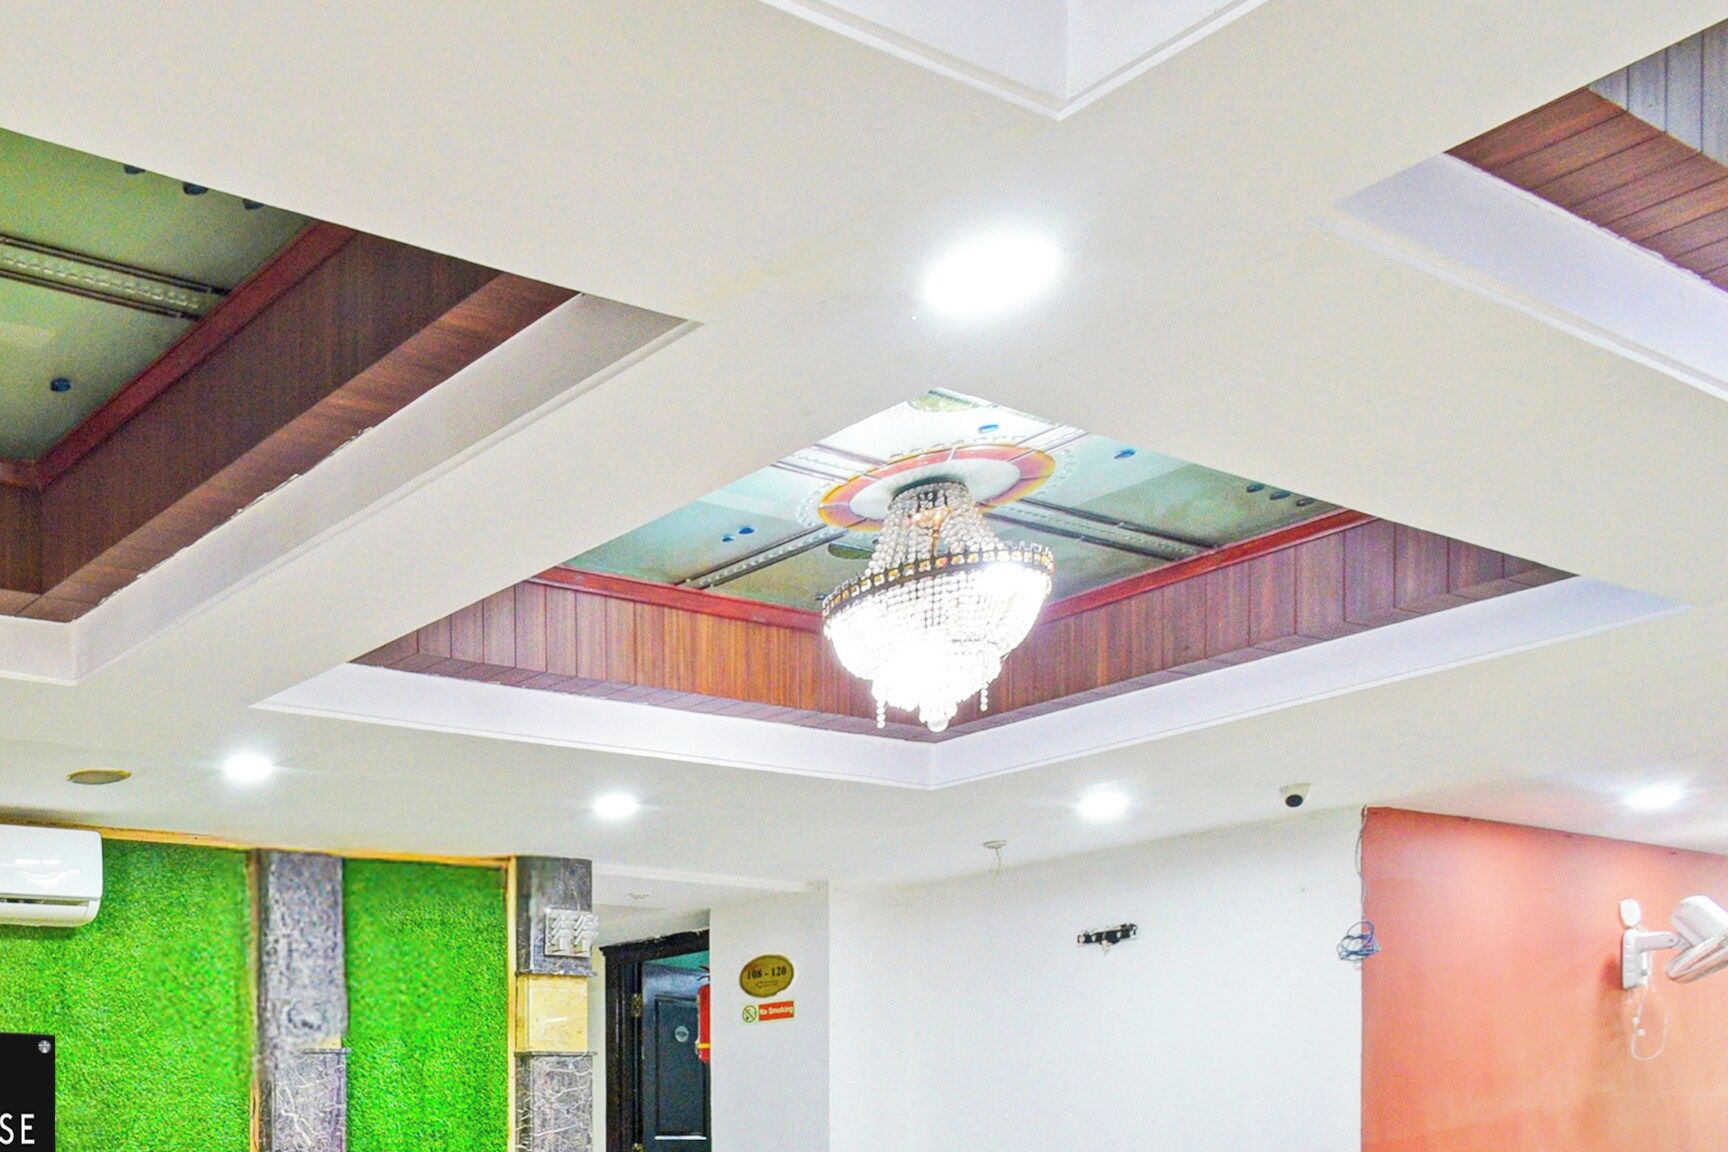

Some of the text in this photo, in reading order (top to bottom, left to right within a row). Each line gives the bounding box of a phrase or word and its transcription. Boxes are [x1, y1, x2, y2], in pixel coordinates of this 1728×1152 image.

[747, 969, 763, 980] 108
[771, 965, 787, 976] 120
[768, 1005, 793, 1016] Smoking
